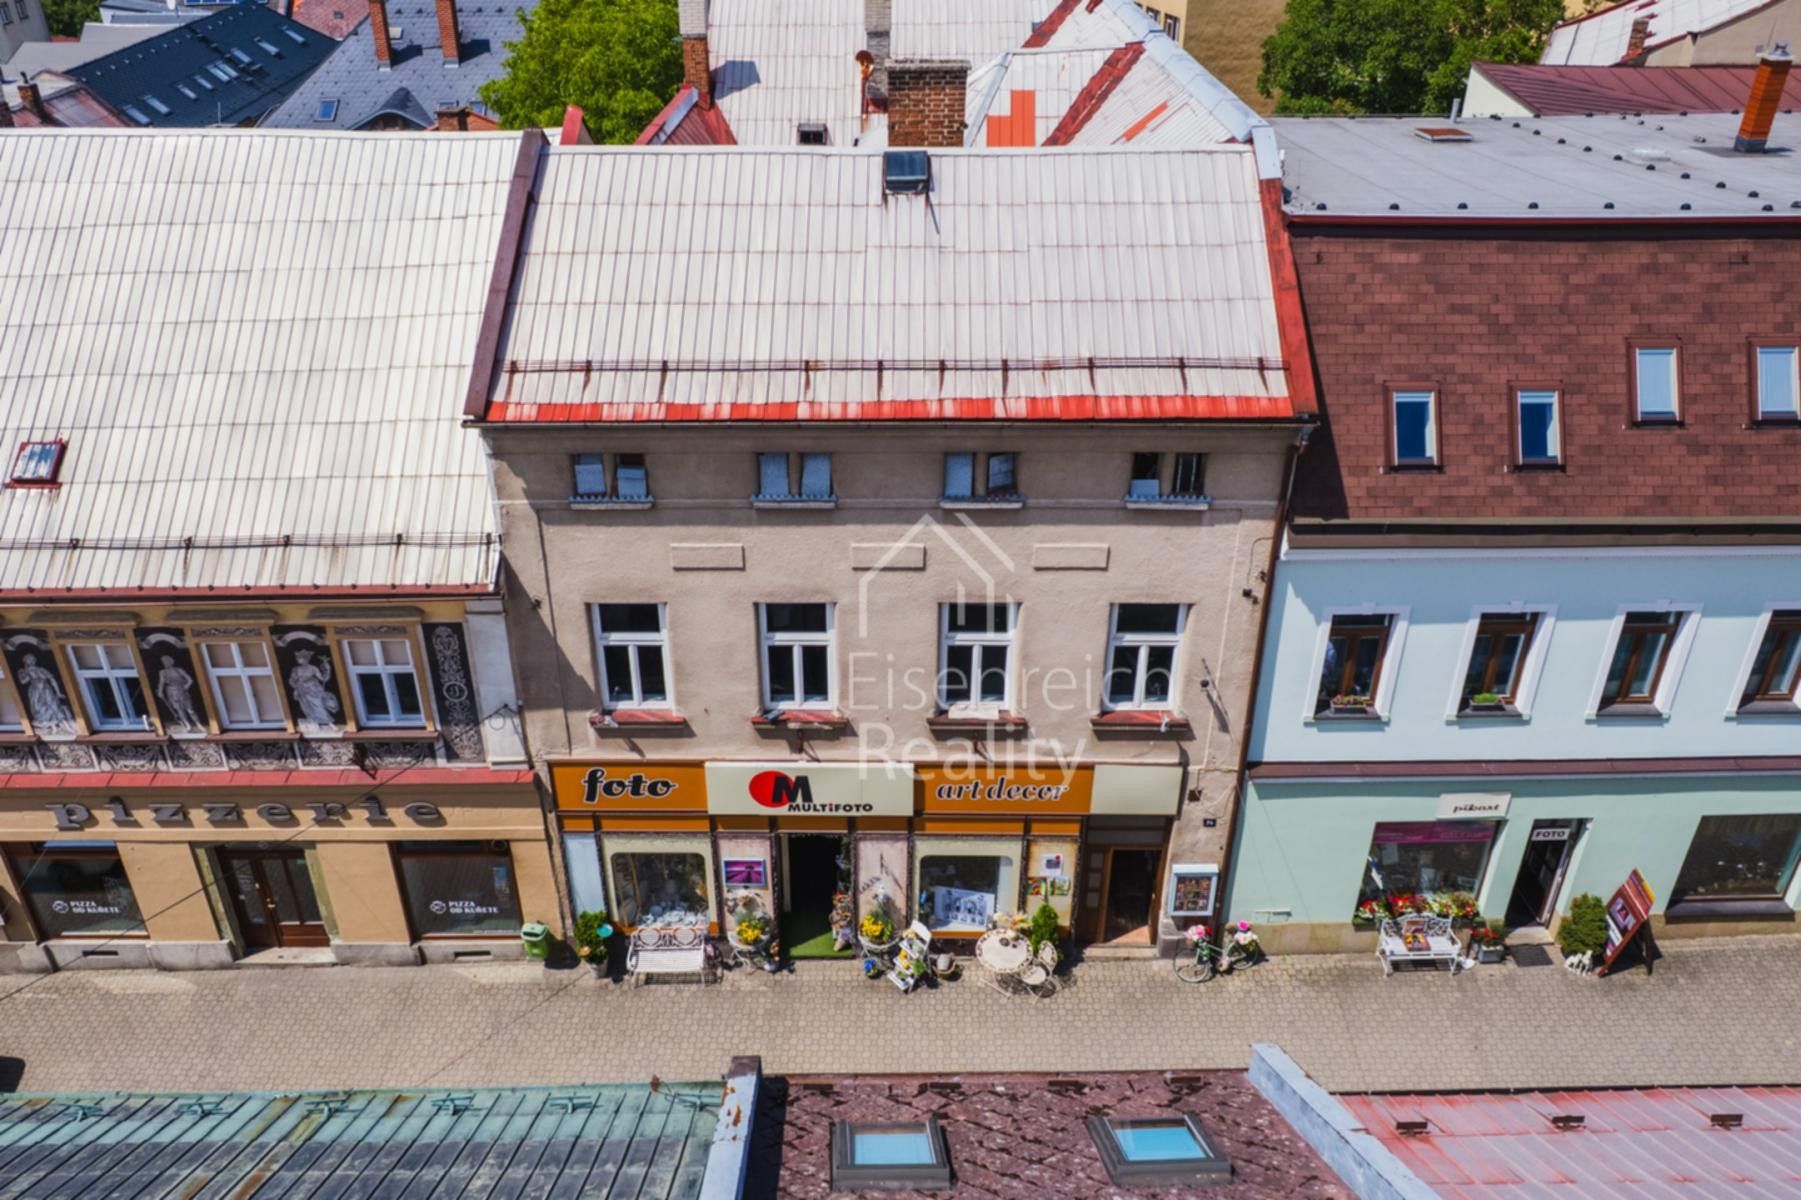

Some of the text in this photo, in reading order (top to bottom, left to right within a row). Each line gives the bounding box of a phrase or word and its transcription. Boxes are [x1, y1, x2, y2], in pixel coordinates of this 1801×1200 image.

[583, 767, 677, 804] foto
[45, 794, 441, 831] pizzerie
[1535, 830, 1566, 838] FOTO
